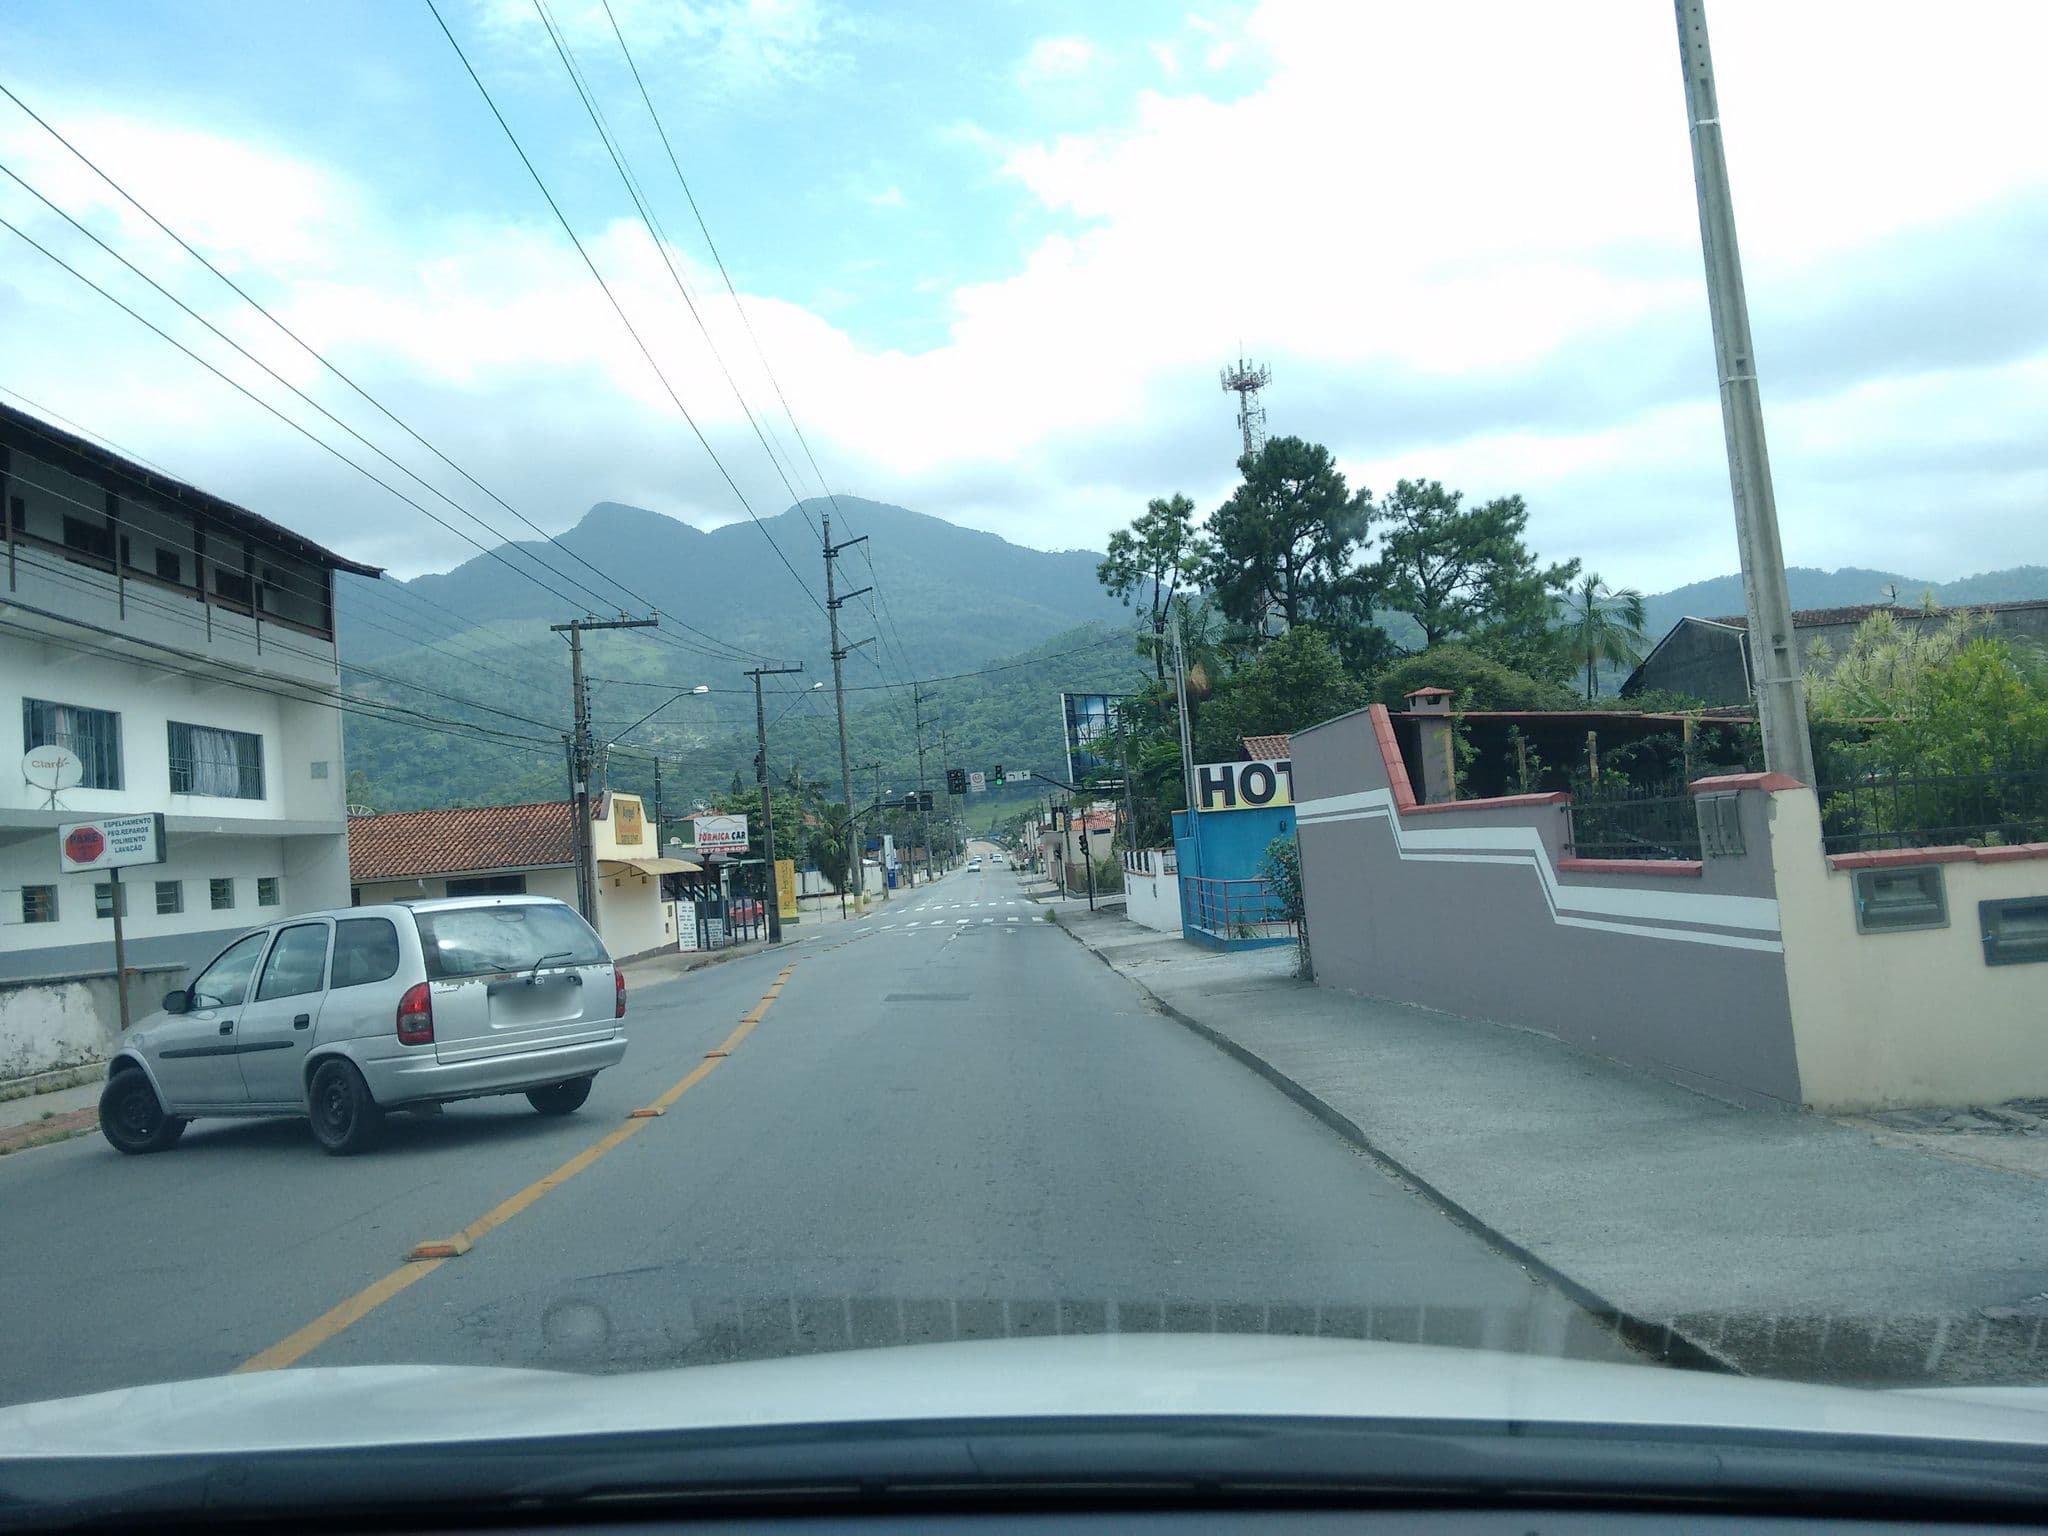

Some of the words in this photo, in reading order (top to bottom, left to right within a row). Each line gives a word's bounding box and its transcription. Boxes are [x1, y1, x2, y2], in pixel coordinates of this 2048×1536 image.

[31, 759, 65, 769] Claro
[103, 817, 152, 828] ESPELHAMENTO
[111, 836, 146, 845] POLIMENTO
[731, 831, 746, 841] CAR
